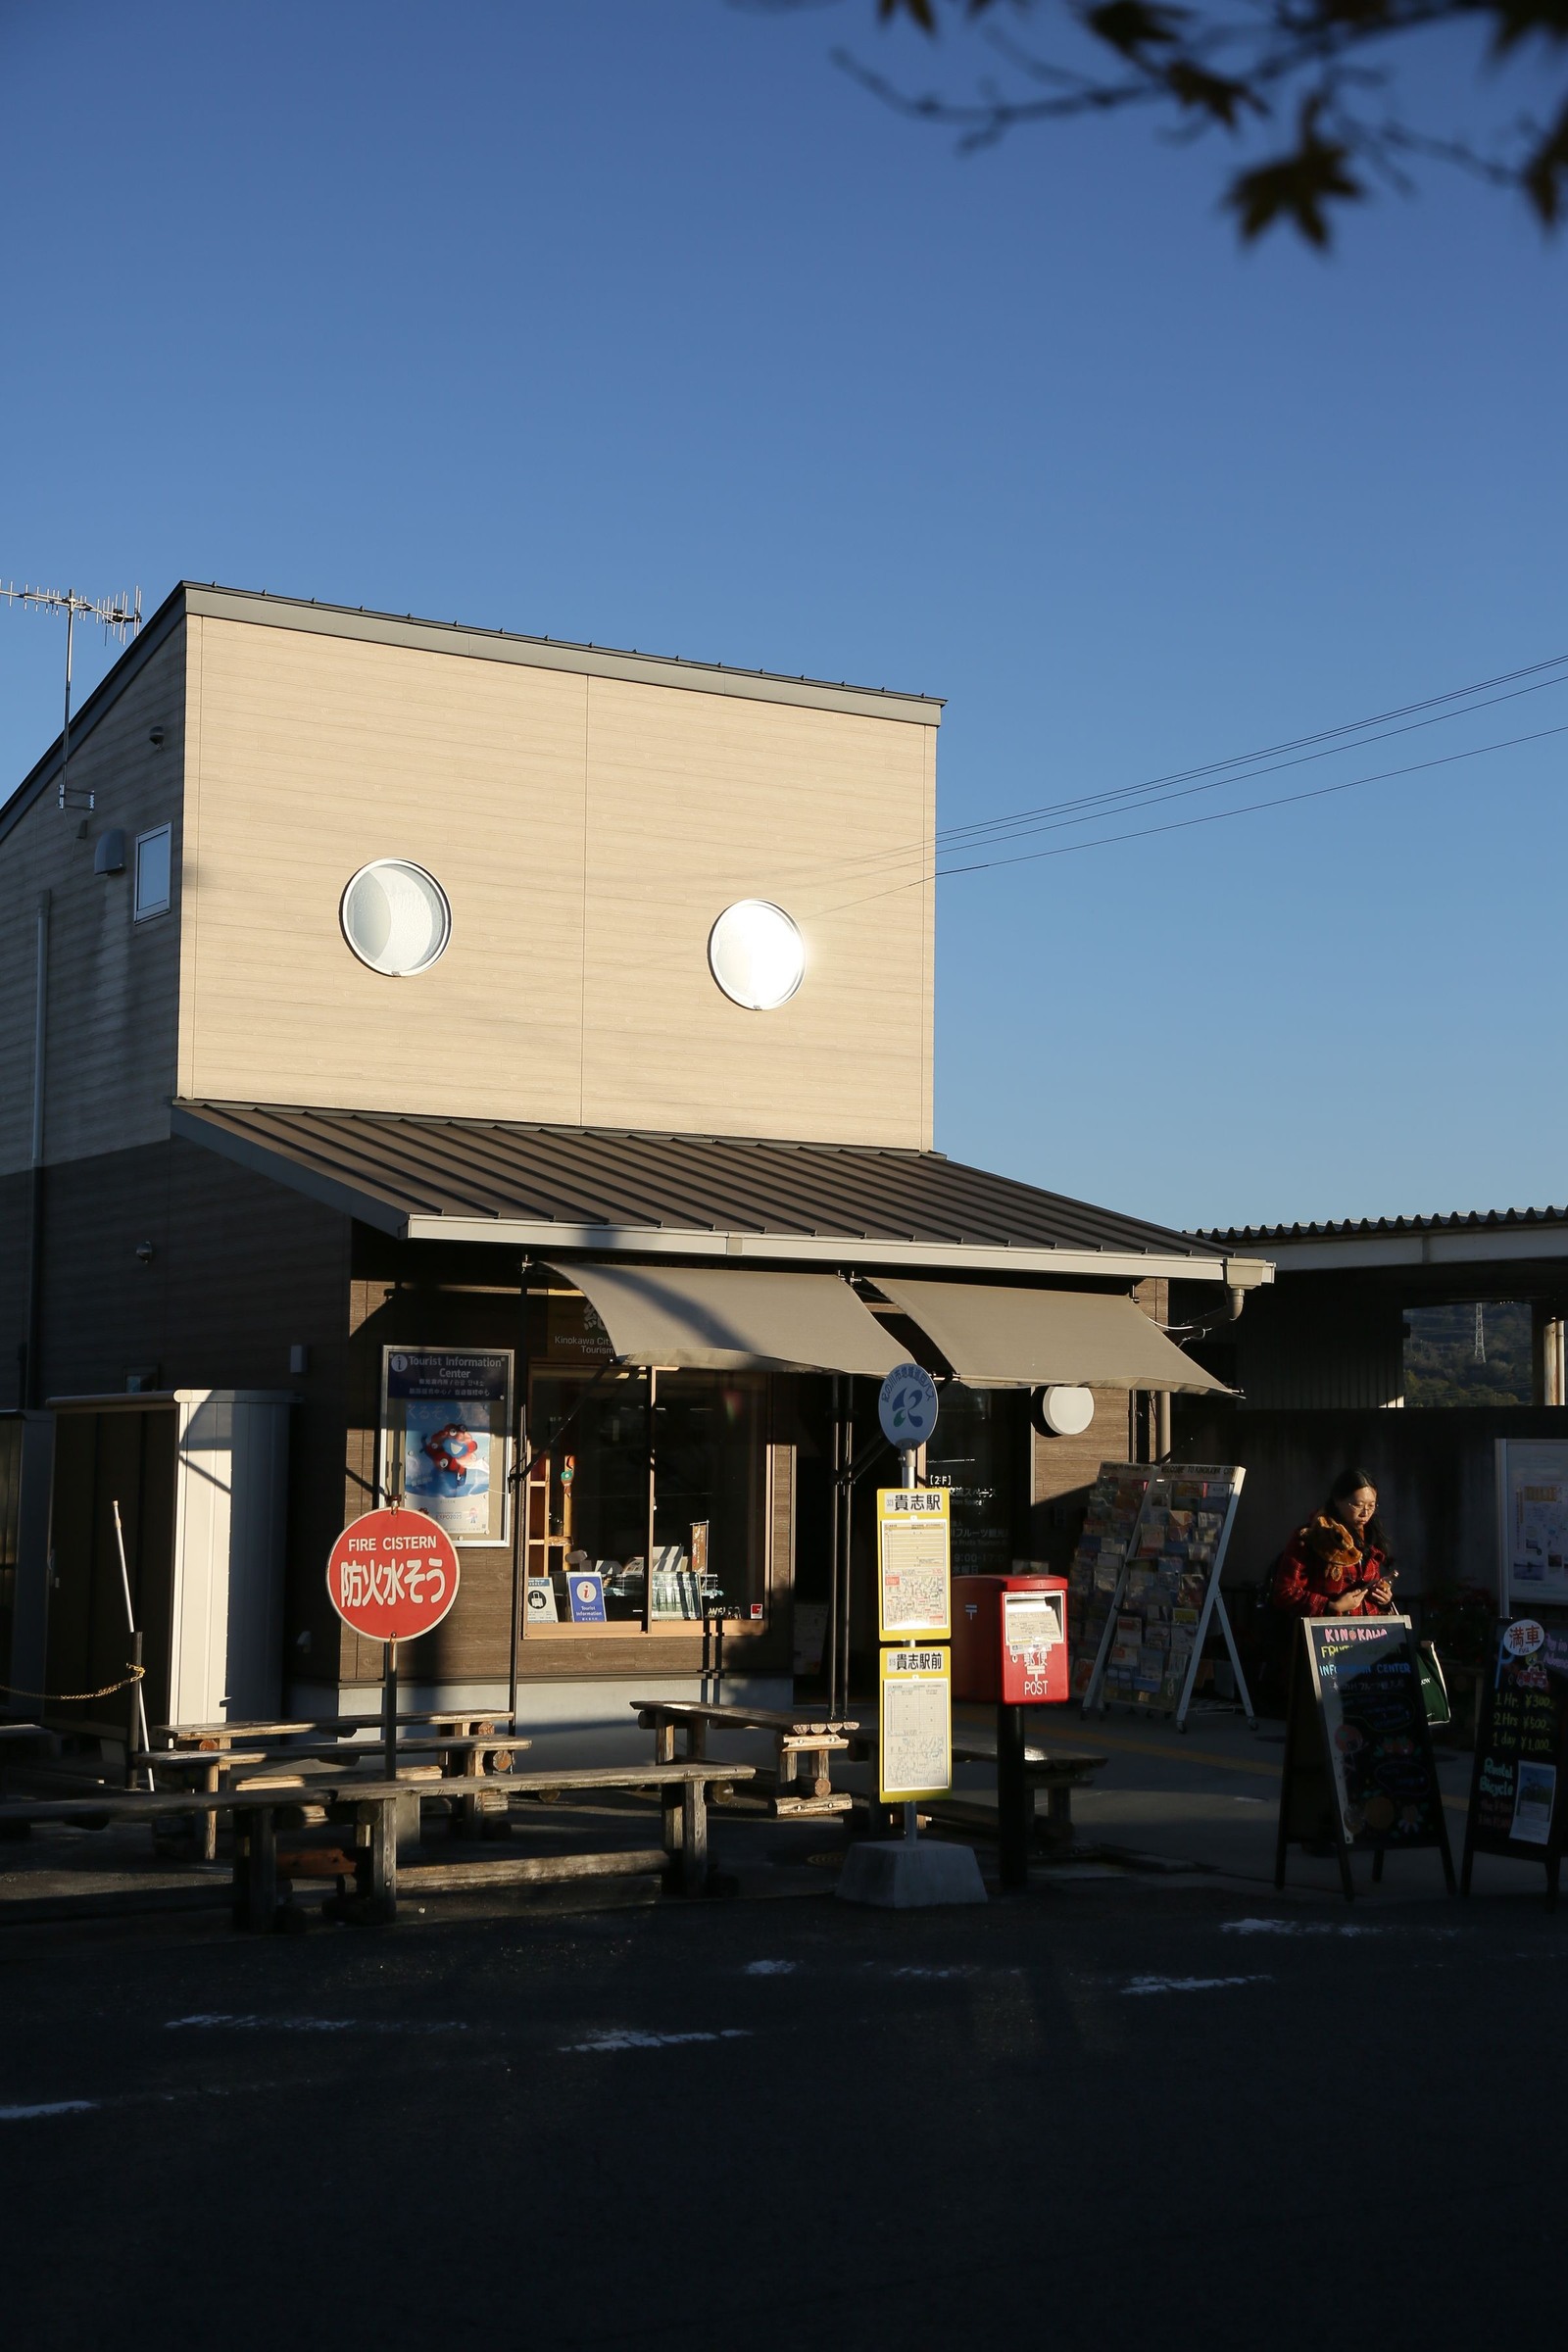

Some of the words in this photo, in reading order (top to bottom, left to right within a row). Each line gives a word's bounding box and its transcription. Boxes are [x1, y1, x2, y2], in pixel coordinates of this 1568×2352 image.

[554, 1335, 595, 1345] Kinokawa
[581, 1345, 614, 1354] Tourism
[408, 1355, 442, 1366] Tourist
[446, 1356, 502, 1367] Information
[439, 1368, 471, 1378] Center
[895, 1494, 941, 1511] 貴志駅
[348, 1538, 376, 1551] FIRE
[382, 1536, 437, 1550] CISTERN
[340, 1558, 446, 1607] 防火水そう
[1510, 1625, 1541, 1648] 満車
[897, 1653, 942, 1670] 貴志駅前
[1376, 1662, 1411, 1674] CENTER
[1024, 1680, 1048, 1695] POST
[1479, 1775, 1513, 1797] Bicycle
